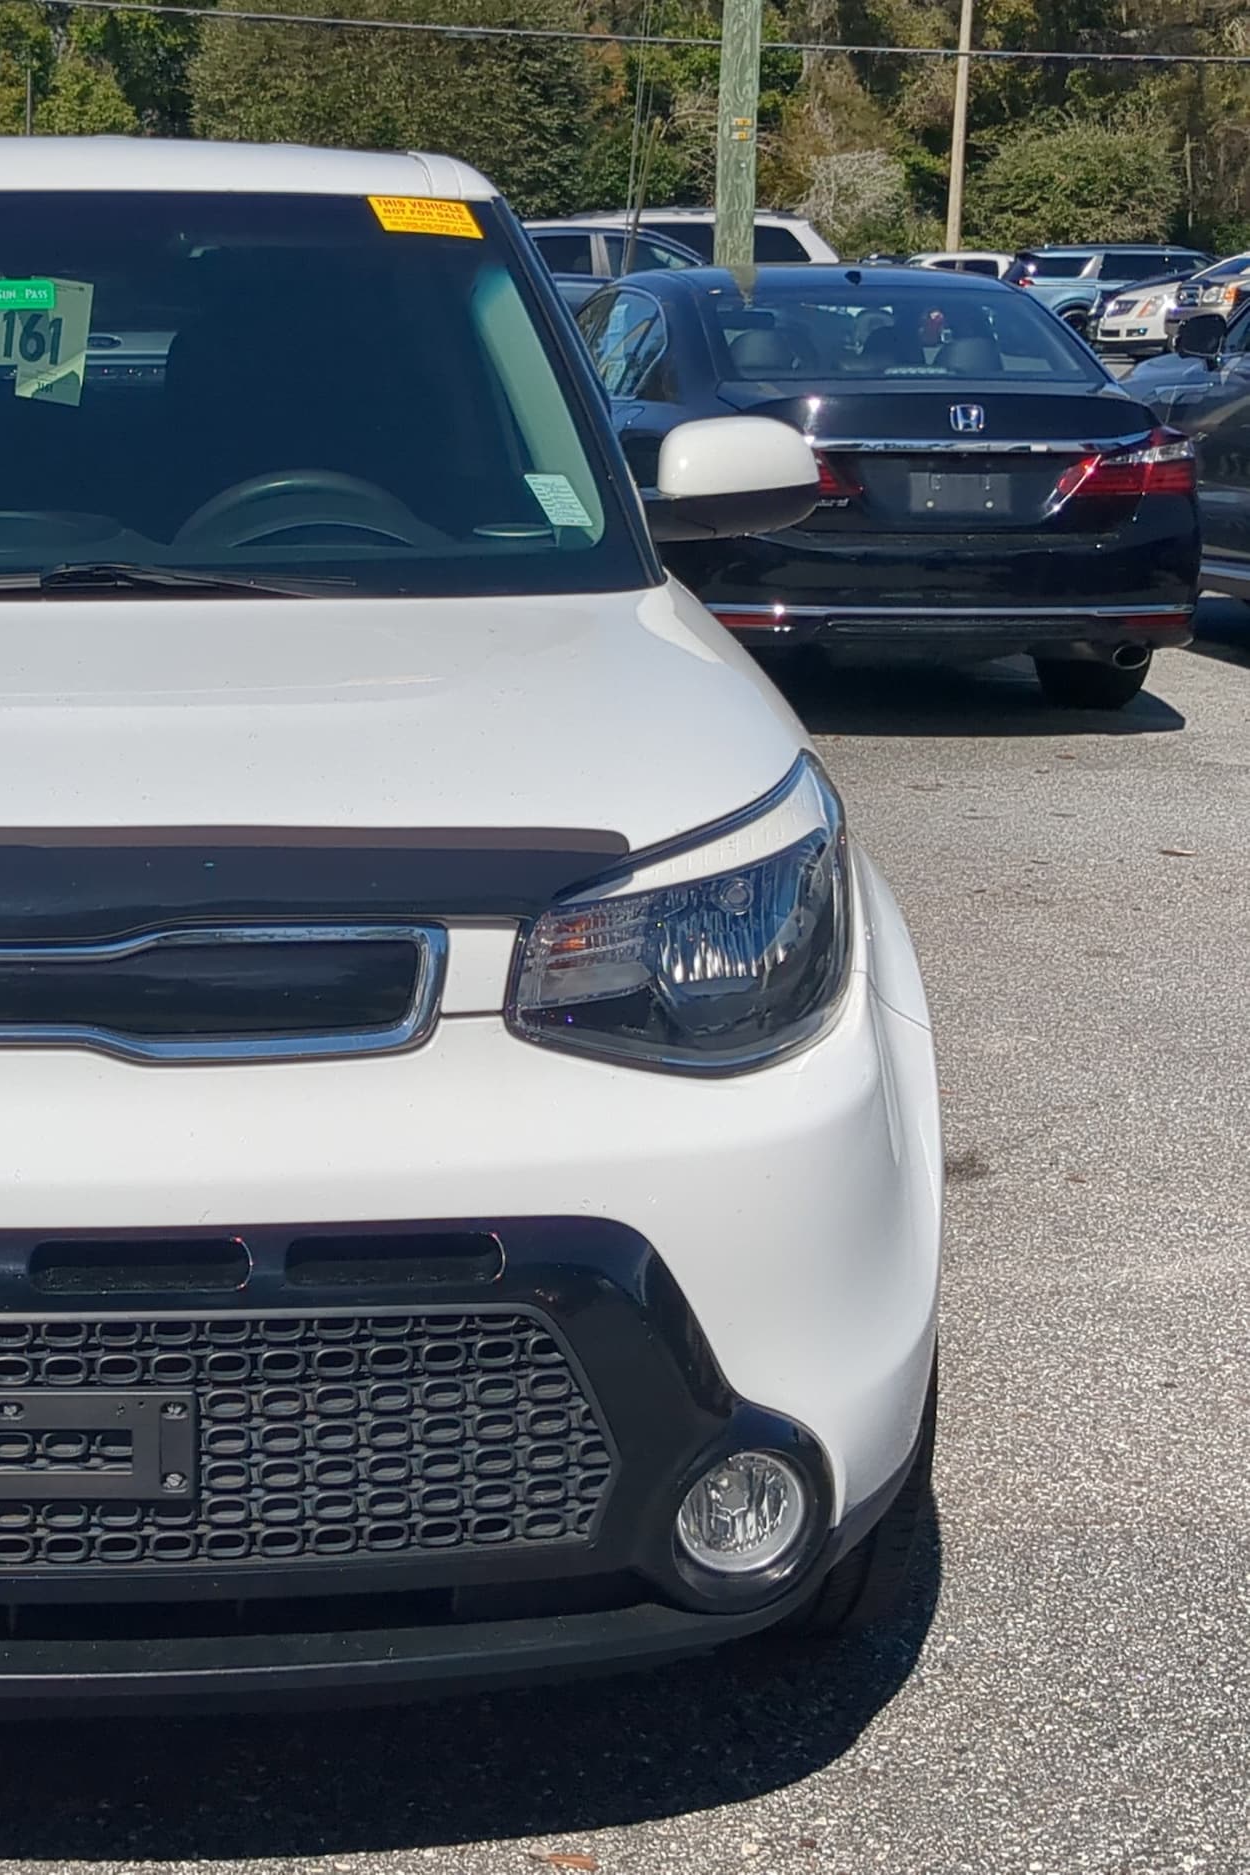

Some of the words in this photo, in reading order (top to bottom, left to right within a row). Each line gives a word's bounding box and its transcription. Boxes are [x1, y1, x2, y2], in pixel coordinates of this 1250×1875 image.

[376, 199, 406, 208] THIS
[408, 199, 464, 214] VEHICLE
[383, 208, 406, 216] NOT
